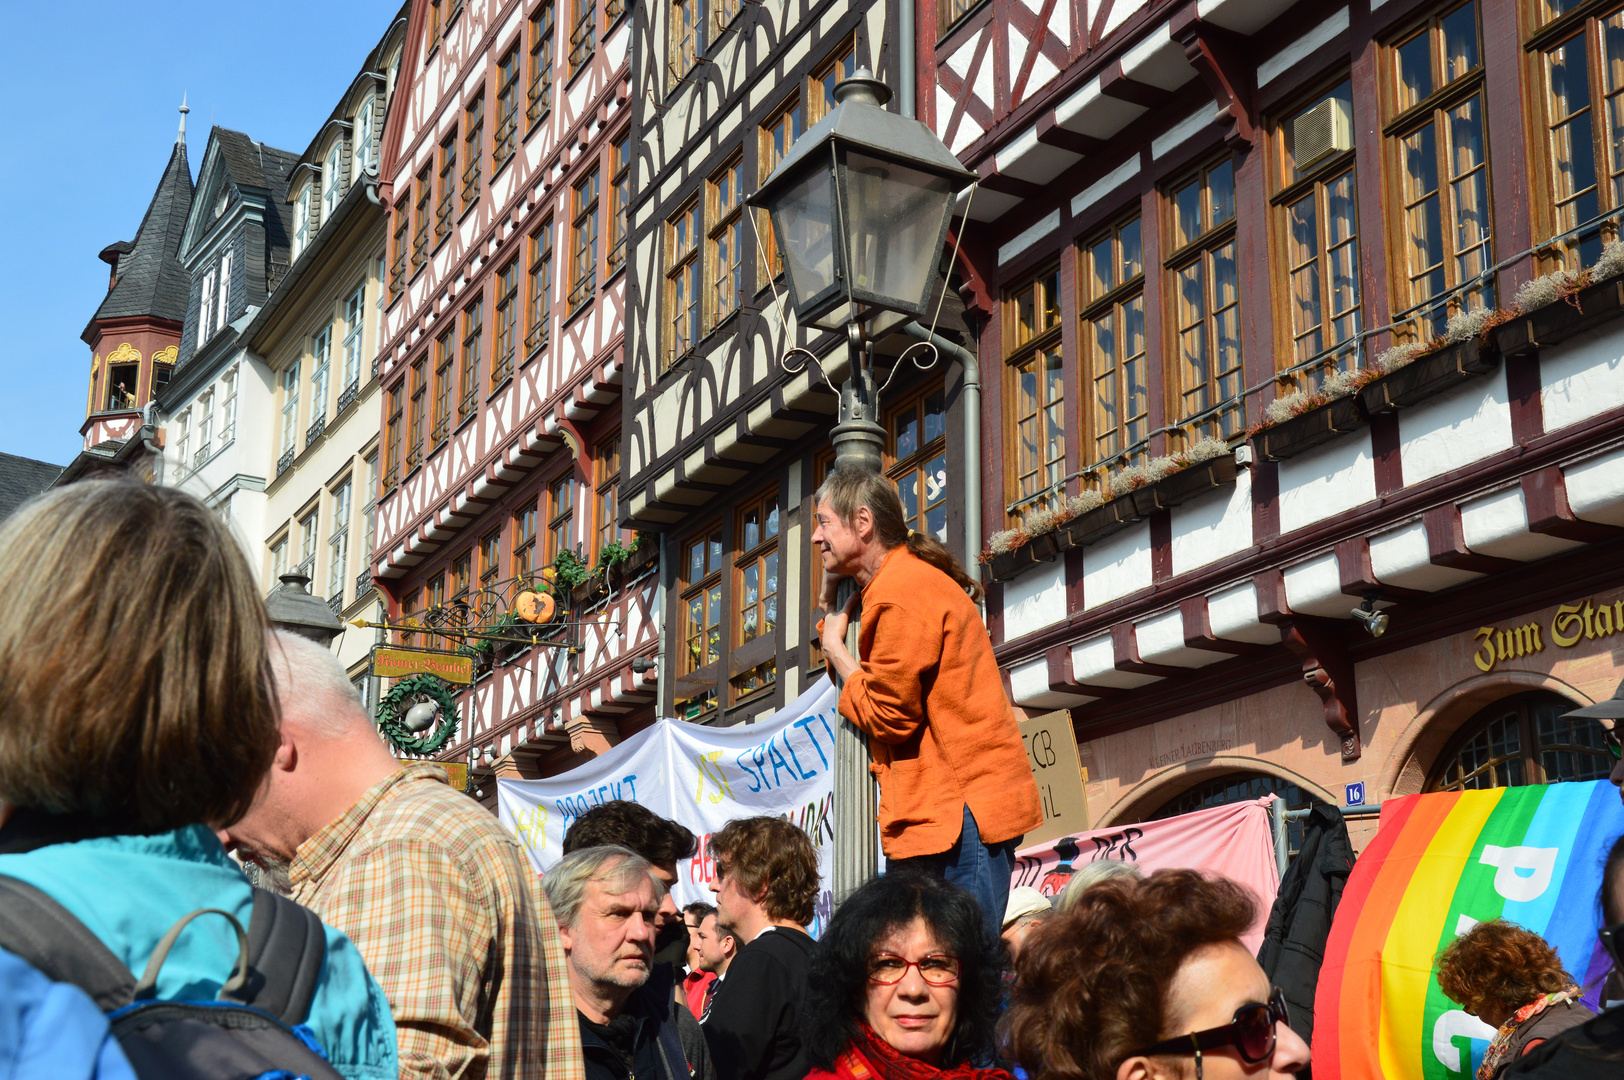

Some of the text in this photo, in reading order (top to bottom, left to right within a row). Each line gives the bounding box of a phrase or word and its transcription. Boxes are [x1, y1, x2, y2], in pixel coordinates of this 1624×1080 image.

[1474, 622, 1543, 672] Zum
[1022, 729, 1056, 772] CB
[1148, 739, 1232, 770] KLEINER LAUBENBERG
[1349, 786, 1361, 802] 16
